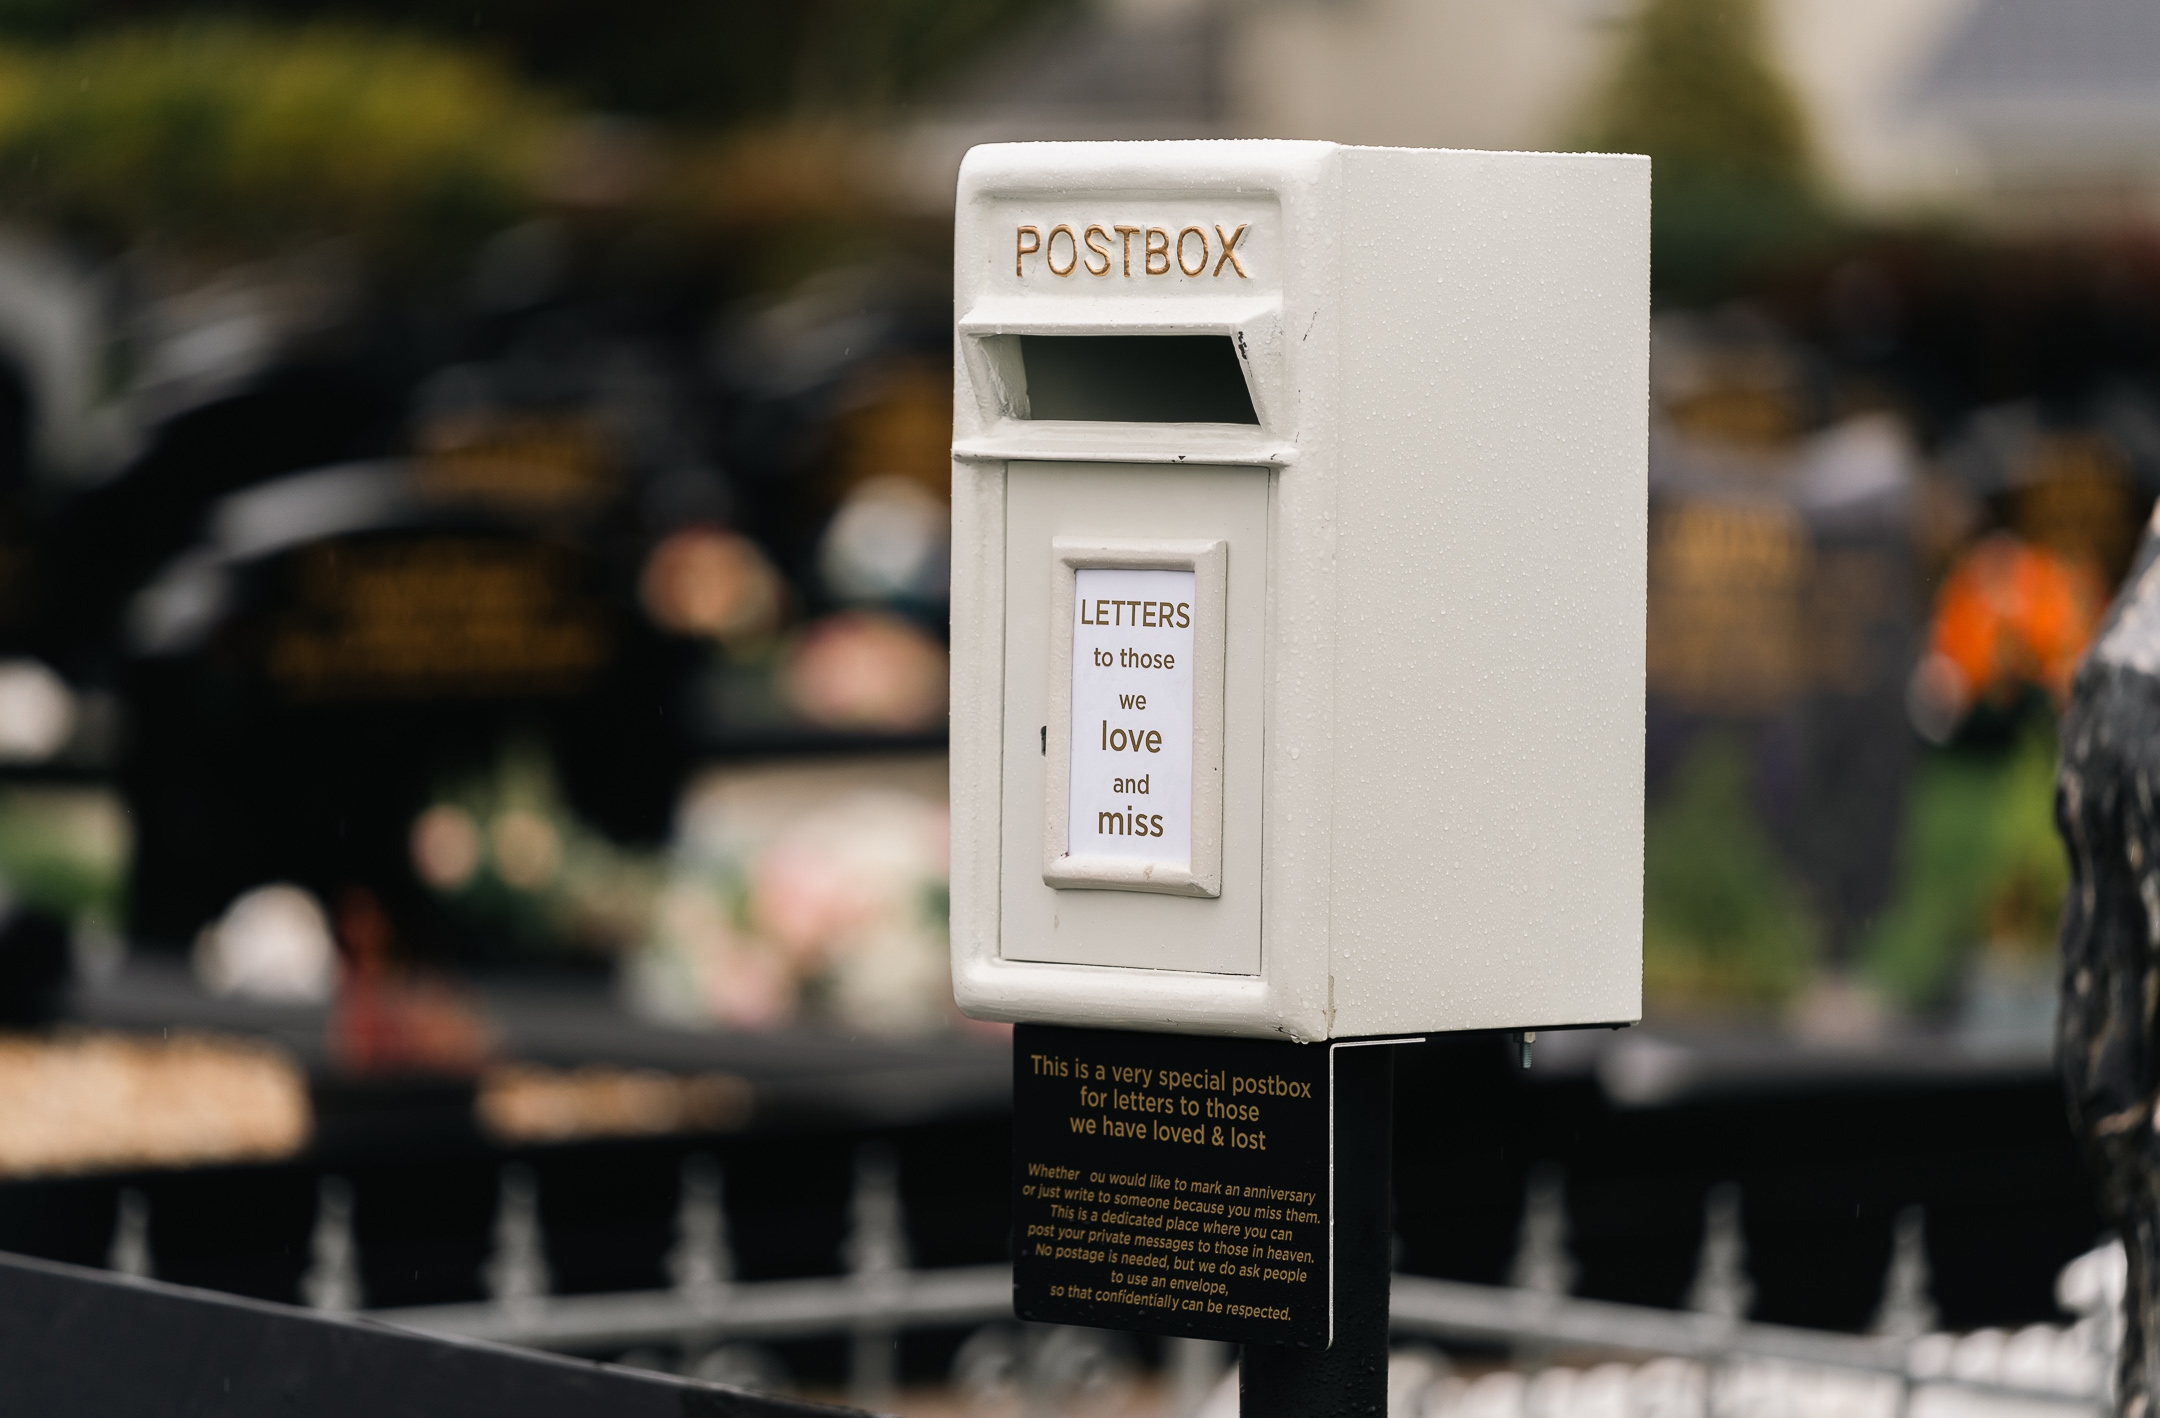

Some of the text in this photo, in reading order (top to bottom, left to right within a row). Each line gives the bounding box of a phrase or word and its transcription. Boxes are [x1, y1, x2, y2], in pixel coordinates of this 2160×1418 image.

[1016, 223, 1248, 279] POSTBOX
[1081, 598, 1191, 629] LETTERS
[1093, 647, 1175, 670] to those
[1119, 693, 1147, 710] we
[1101, 719, 1163, 754] love
[1113, 774, 1150, 795] and
[1098, 805, 1164, 838] miss
[1031, 1054, 1312, 1099] This is a very special postbox
[1080, 1085, 1260, 1123] for letters to those
[1070, 1115, 1266, 1151] we have loved & lost
[1028, 1162, 1081, 1181] Whether
[1109, 1172, 1147, 1188] would
[1149, 1174, 1171, 1191] like
[1174, 1177, 1188, 1191] to
[1190, 1180, 1222, 1195] mark
[1224, 1184, 1241, 1197] an
[1243, 1185, 1317, 1206] anniversary
[1022, 1183, 1321, 1225] or just write to someone because you miss them.
[1050, 1204, 1293, 1242] This is a dedicated place where you can
[1027, 1223, 1315, 1264] post your private messages to those in heaven.
[1035, 1242, 1308, 1284] No postage is needed, but we do ask people
[1110, 1269, 1229, 1297] to use an envelope,
[1049, 1284, 1291, 1322] so that confidentially can be respected.
